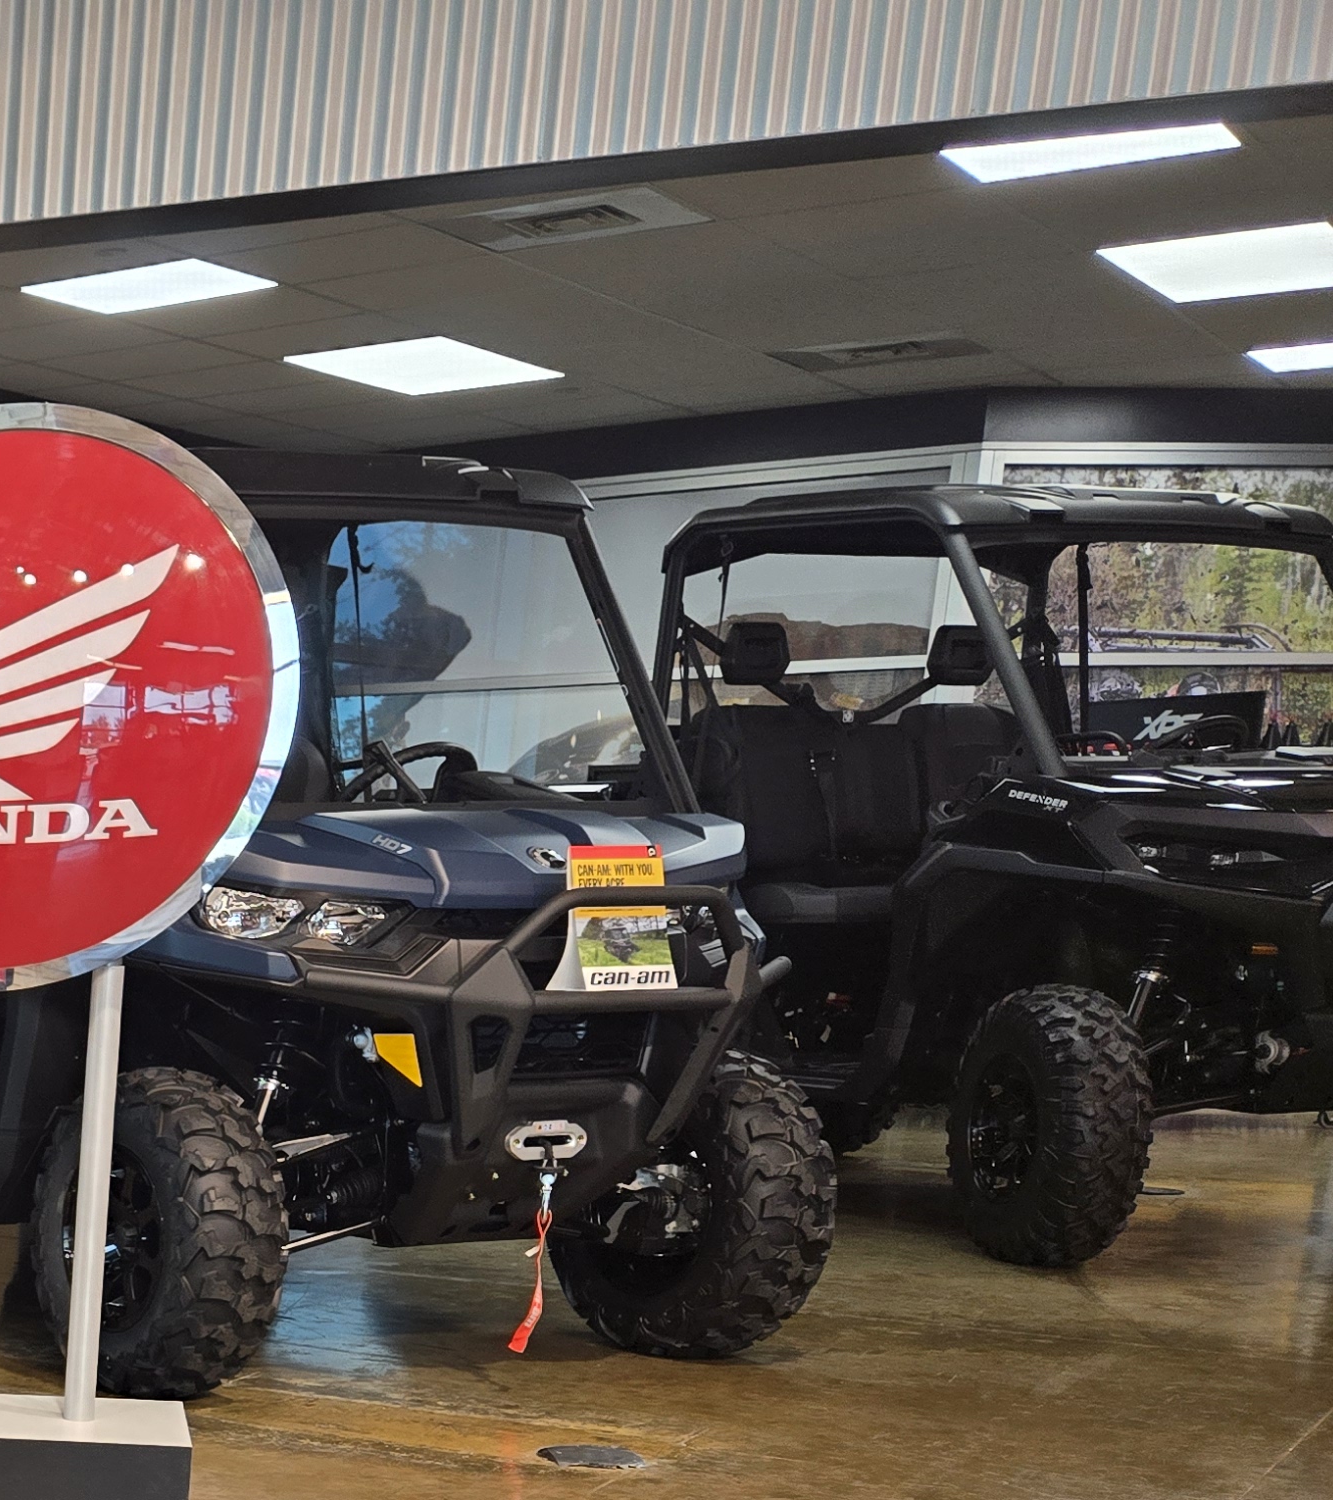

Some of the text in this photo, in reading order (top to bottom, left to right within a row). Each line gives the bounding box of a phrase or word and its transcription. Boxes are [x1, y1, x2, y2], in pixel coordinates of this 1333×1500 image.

[1008, 789, 1069, 809] DEFENDER
[371, 834, 413, 855] HD7
[613, 863, 634, 876] WITH
[636, 863, 655, 876] YOU.
[590, 969, 670, 986] can-am
